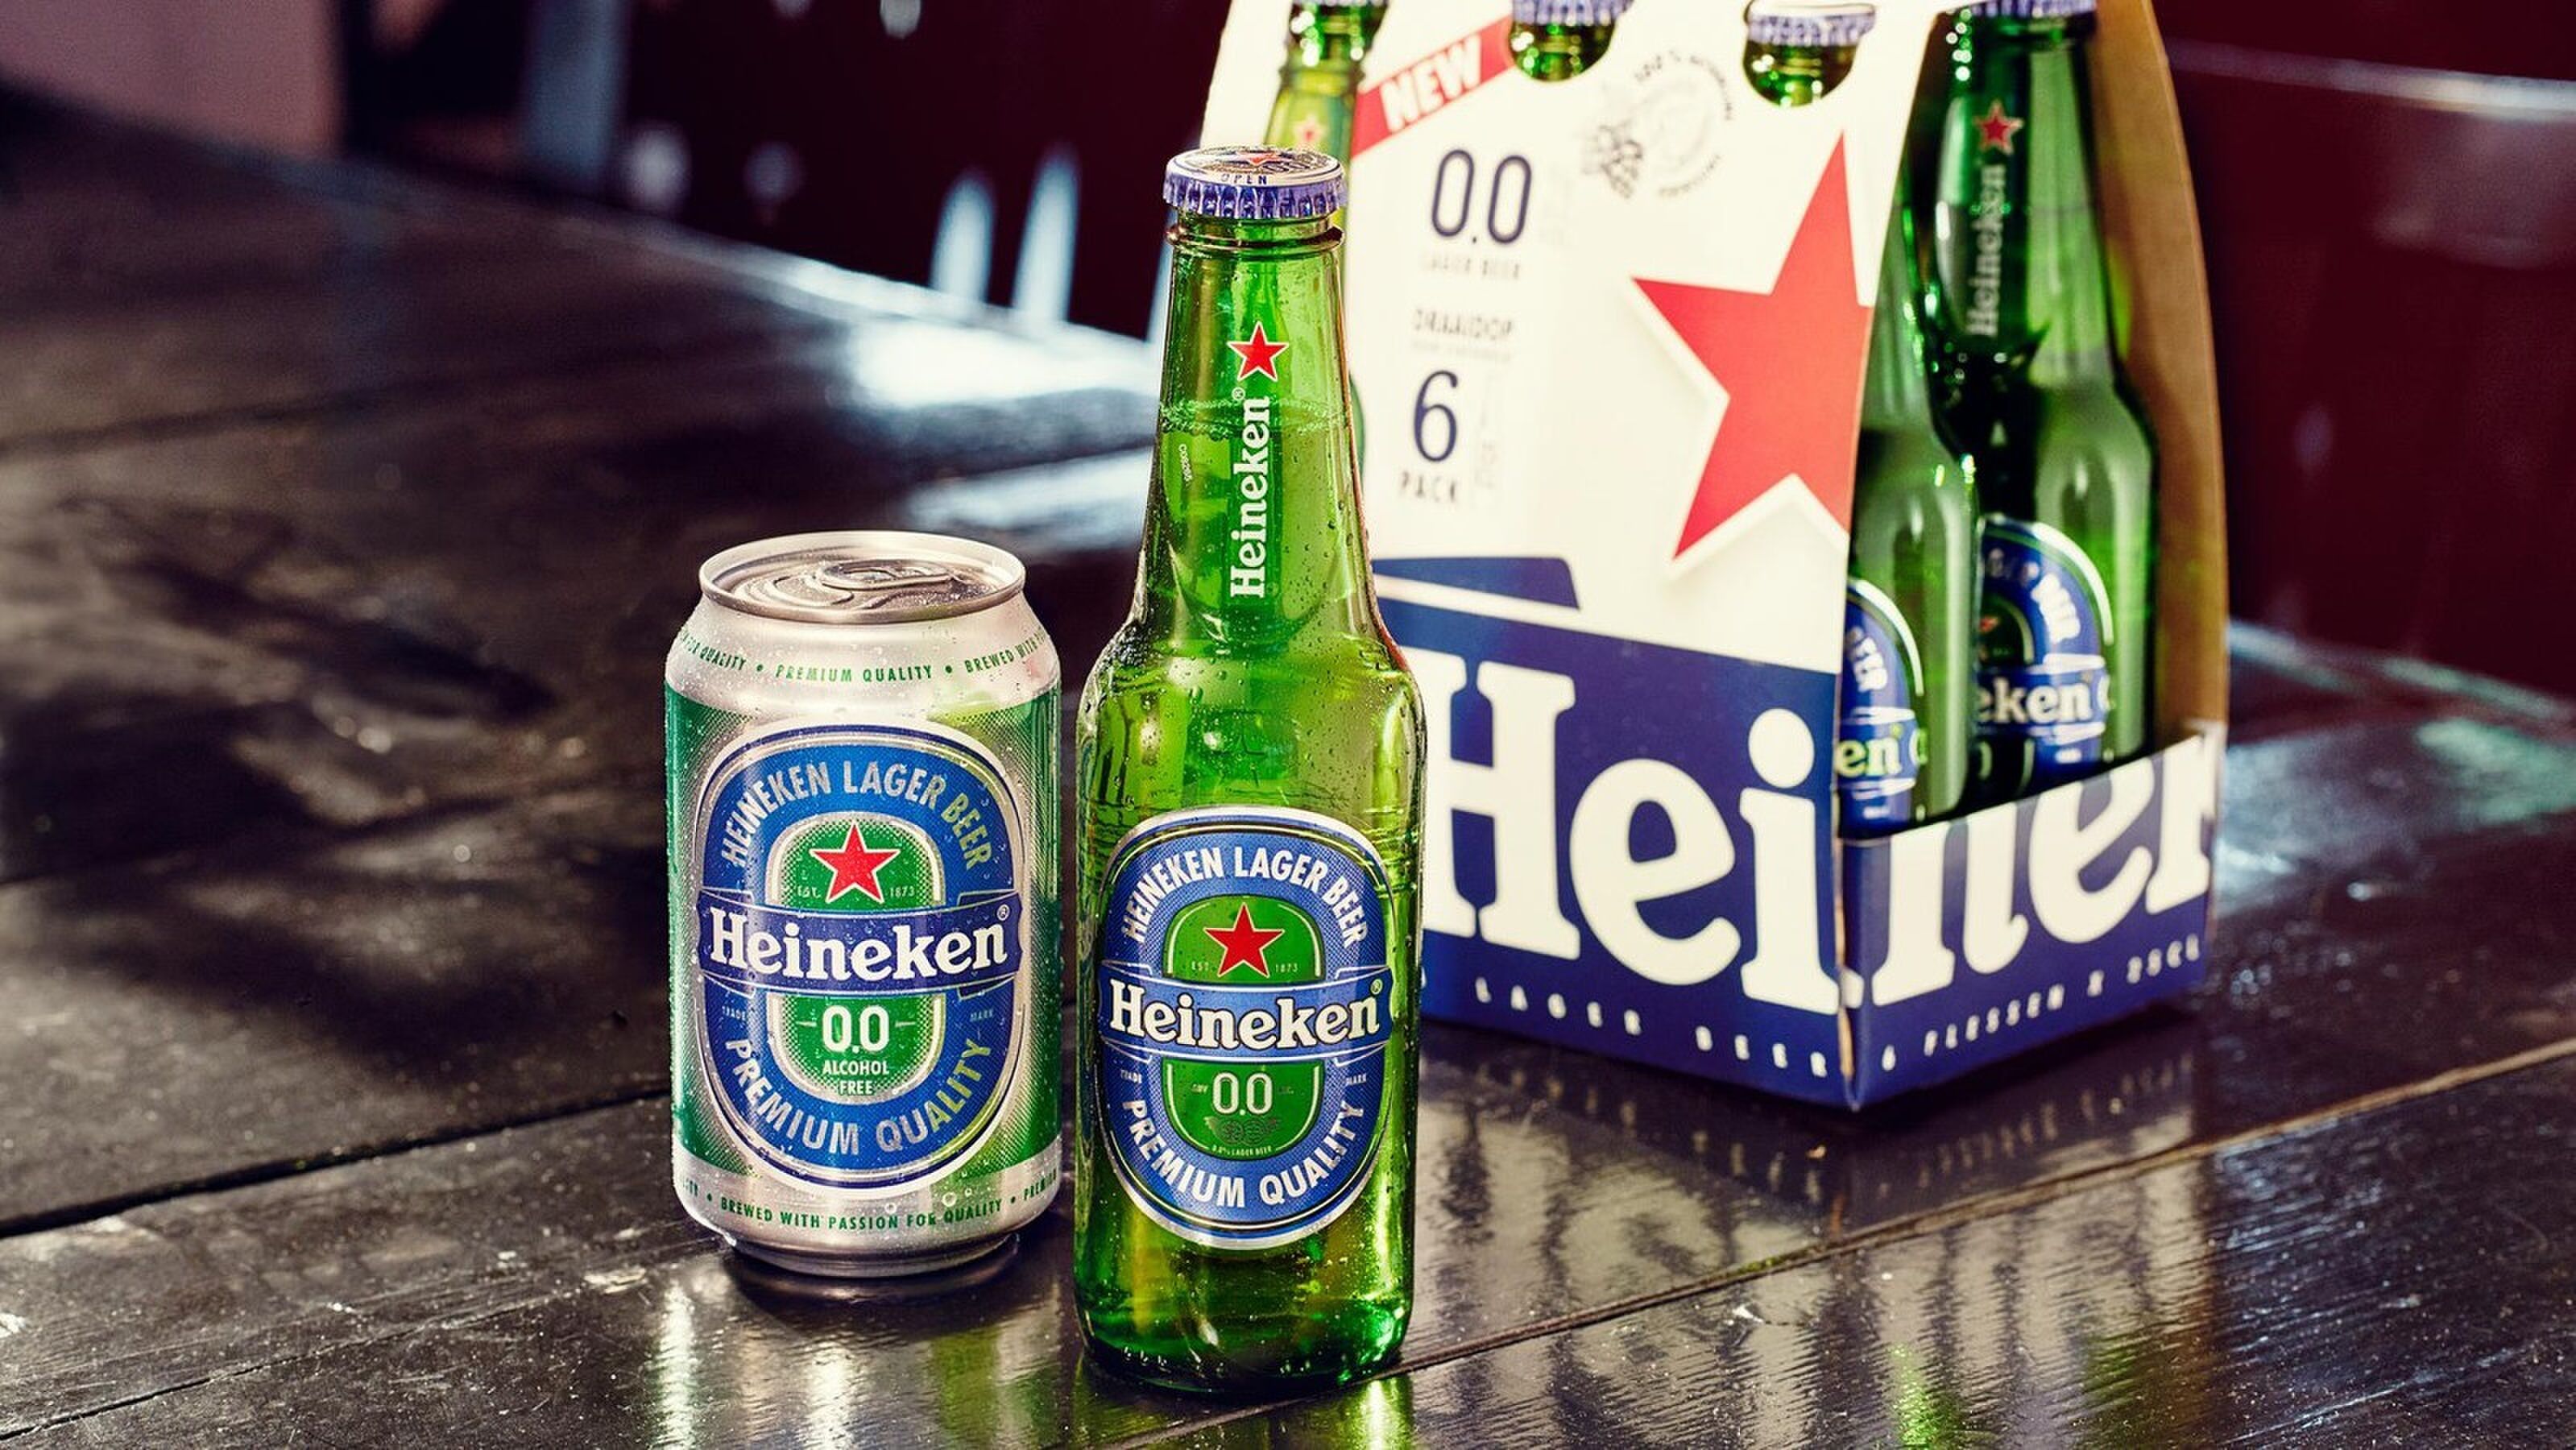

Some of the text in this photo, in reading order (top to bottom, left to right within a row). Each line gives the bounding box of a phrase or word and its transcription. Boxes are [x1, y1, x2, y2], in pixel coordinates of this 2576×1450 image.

[1379, 33, 1481, 134] NEW
[1431, 149, 1532, 246] 0.0
[1967, 164, 2007, 338] Heineken
[1413, 369, 1460, 462] 6
[1230, 396, 1270, 599] Heineken
[699, 646, 747, 670] QUALITY
[775, 664, 932, 682] PREMIUM QUALITY
[964, 649, 1014, 673] BREWED
[721, 761, 993, 871] HEINEKEN LAGER BEER
[889, 885, 915, 898] 1873
[1120, 847, 1368, 949] HEINEKEN LAGER BEER
[822, 1005, 889, 1054] 0.0
[822, 1060, 890, 1075] ALCOHOL
[1476, 977, 1828, 1078] LAGER BEER
[726, 1038, 992, 1156] PREMIUM QUALITY
[839, 1081, 874, 1096] FREE
[1212, 1072, 1273, 1116] 0.0
[1121, 1098, 1365, 1208] PREMIUM QUALITY
[721, 1196, 1002, 1230] BREWED WITH PASSION FOR QUALITY
